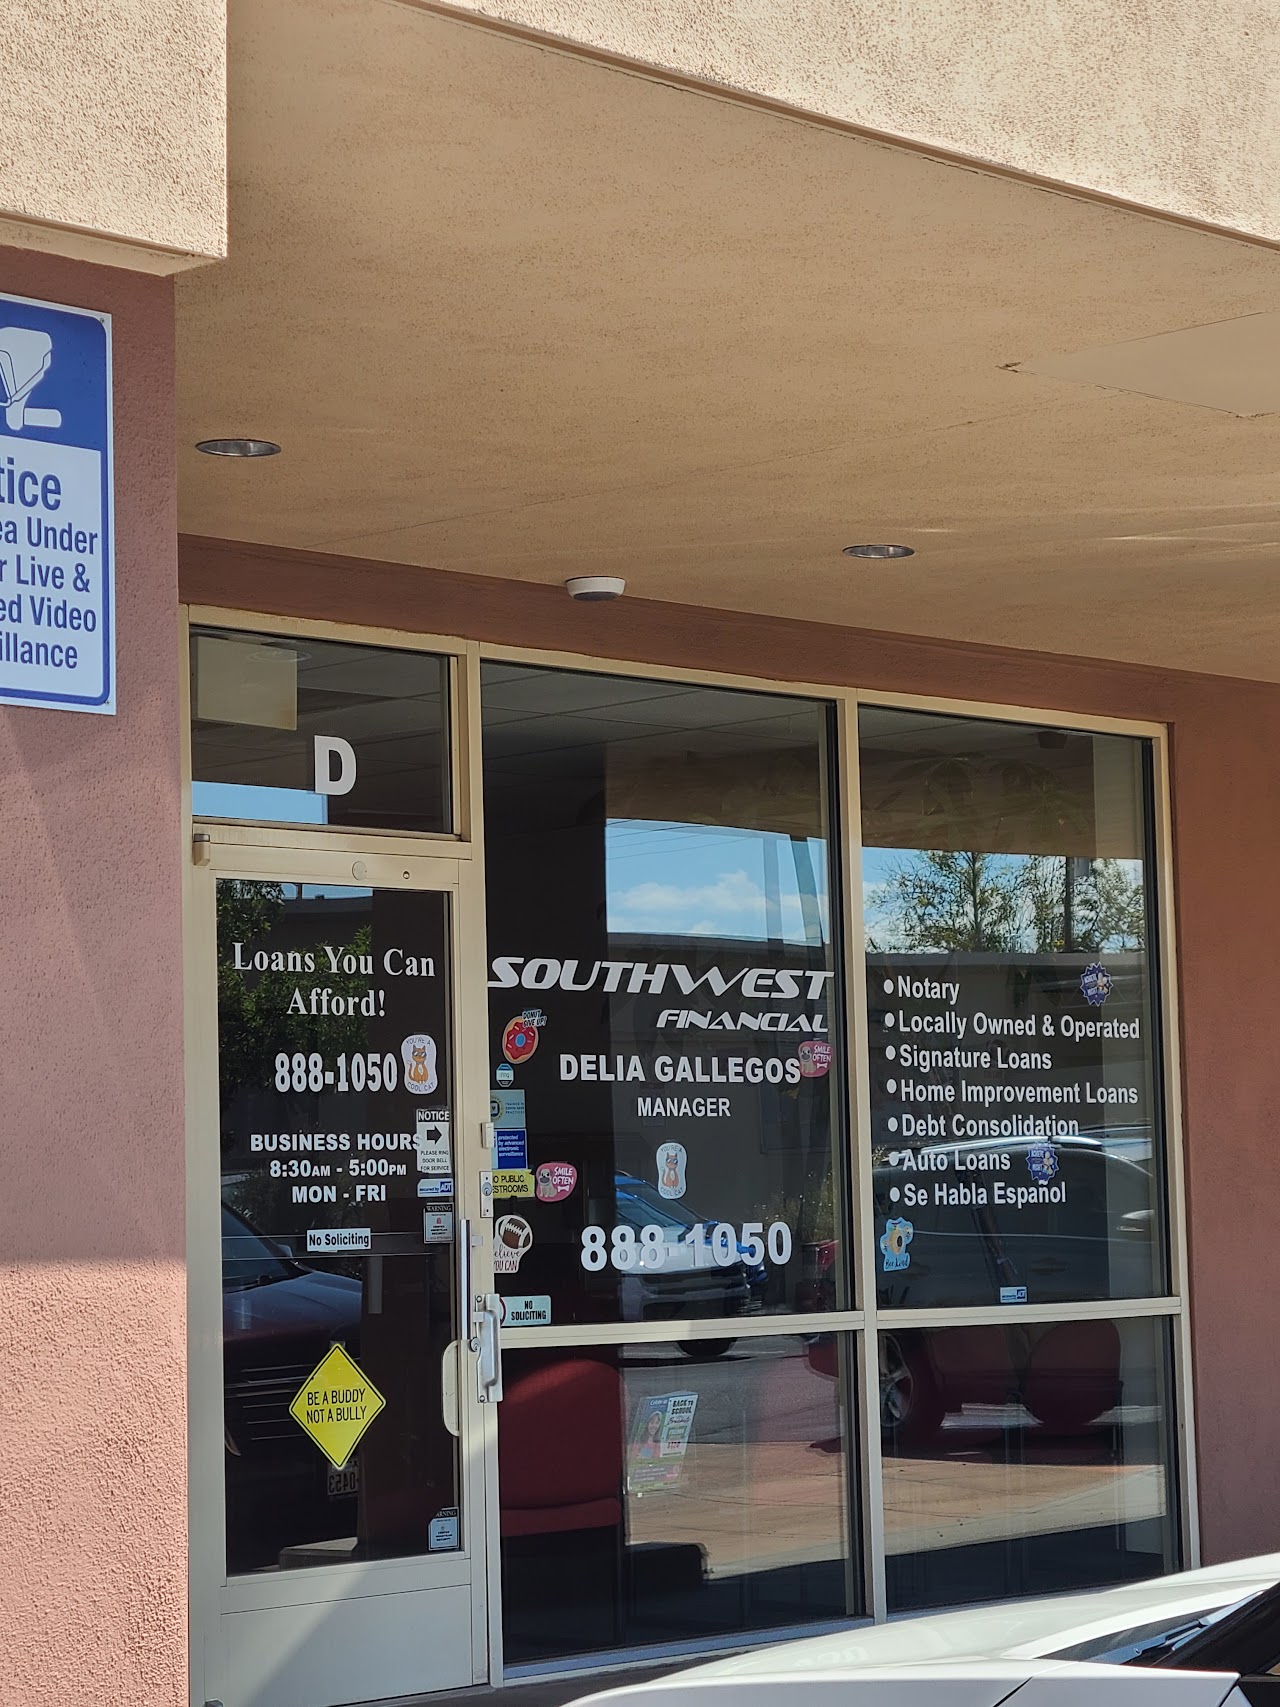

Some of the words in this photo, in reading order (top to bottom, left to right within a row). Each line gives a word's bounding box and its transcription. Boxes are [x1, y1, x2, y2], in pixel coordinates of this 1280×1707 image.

[0, 519, 17, 545] a
[27, 516, 98, 555] Under
[16, 554, 64, 590] Live
[73, 562, 90, 593] &
[29, 595, 96, 632] Video
[314, 734, 357, 796] D
[232, 942, 315, 973] Loans
[323, 946, 374, 975] You
[383, 948, 436, 977] Can
[487, 956, 835, 1000] SOUTHWEST
[897, 975, 960, 1005] Notary
[286, 987, 386, 1017] Afford!
[656, 1008, 829, 1033] FINANCIAL
[899, 1010, 967, 1039] Locally
[973, 1012, 1036, 1036] Owned
[1042, 1014, 1055, 1037] &
[1060, 1015, 1141, 1042] Operated
[812, 1053, 831, 1062] OFTEN
[813, 1045, 831, 1054] SMILE
[900, 1044, 991, 1073] Signature
[997, 1047, 1052, 1070] Loans
[275, 1053, 398, 1092] 888-1050
[560, 1054, 646, 1081] DELIA
[654, 1055, 801, 1084] GALLEGOS
[901, 1079, 956, 1102] Home
[961, 1080, 1081, 1107] Improvement
[1085, 1082, 1138, 1104] Loans
[418, 1111, 450, 1121] NOTICE
[637, 1097, 732, 1118] MANAGER
[902, 1114, 947, 1137] Debt
[952, 1114, 1080, 1137] Consolidation
[250, 1133, 351, 1151] BUSINESS
[357, 1133, 422, 1150] HOURS
[269, 1160, 331, 1178] 8:30AM
[349, 1159, 407, 1177] 5:00PM
[902, 1149, 948, 1171] Auto
[955, 1150, 1011, 1171] Loans
[493, 1175, 499, 1184] O
[501, 1174, 525, 1183] PUBLIC
[552, 1176, 574, 1185] OFTEN
[554, 1166, 573, 1176] SMILE
[292, 1185, 337, 1203] MON
[356, 1185, 387, 1202] FRI
[492, 1184, 529, 1194] ESTROOMS
[904, 1183, 928, 1206] Se
[934, 1183, 987, 1205] Habla
[994, 1179, 1066, 1208] Español
[309, 1234, 322, 1246] No
[325, 1232, 370, 1247] Soliciting
[580, 1221, 792, 1272] 888-1050
[494, 1244, 521, 1259] elieve
[505, 1260, 518, 1272] CAN
[511, 1310, 547, 1321] SOLICITING
[524, 1300, 533, 1310] NO
[307, 1391, 320, 1406] BE
[322, 1391, 329, 1405] A
[332, 1388, 366, 1404] BUDDY
[306, 1409, 325, 1424] NOT
[327, 1408, 334, 1423] A
[336, 1406, 367, 1421] BULLY
